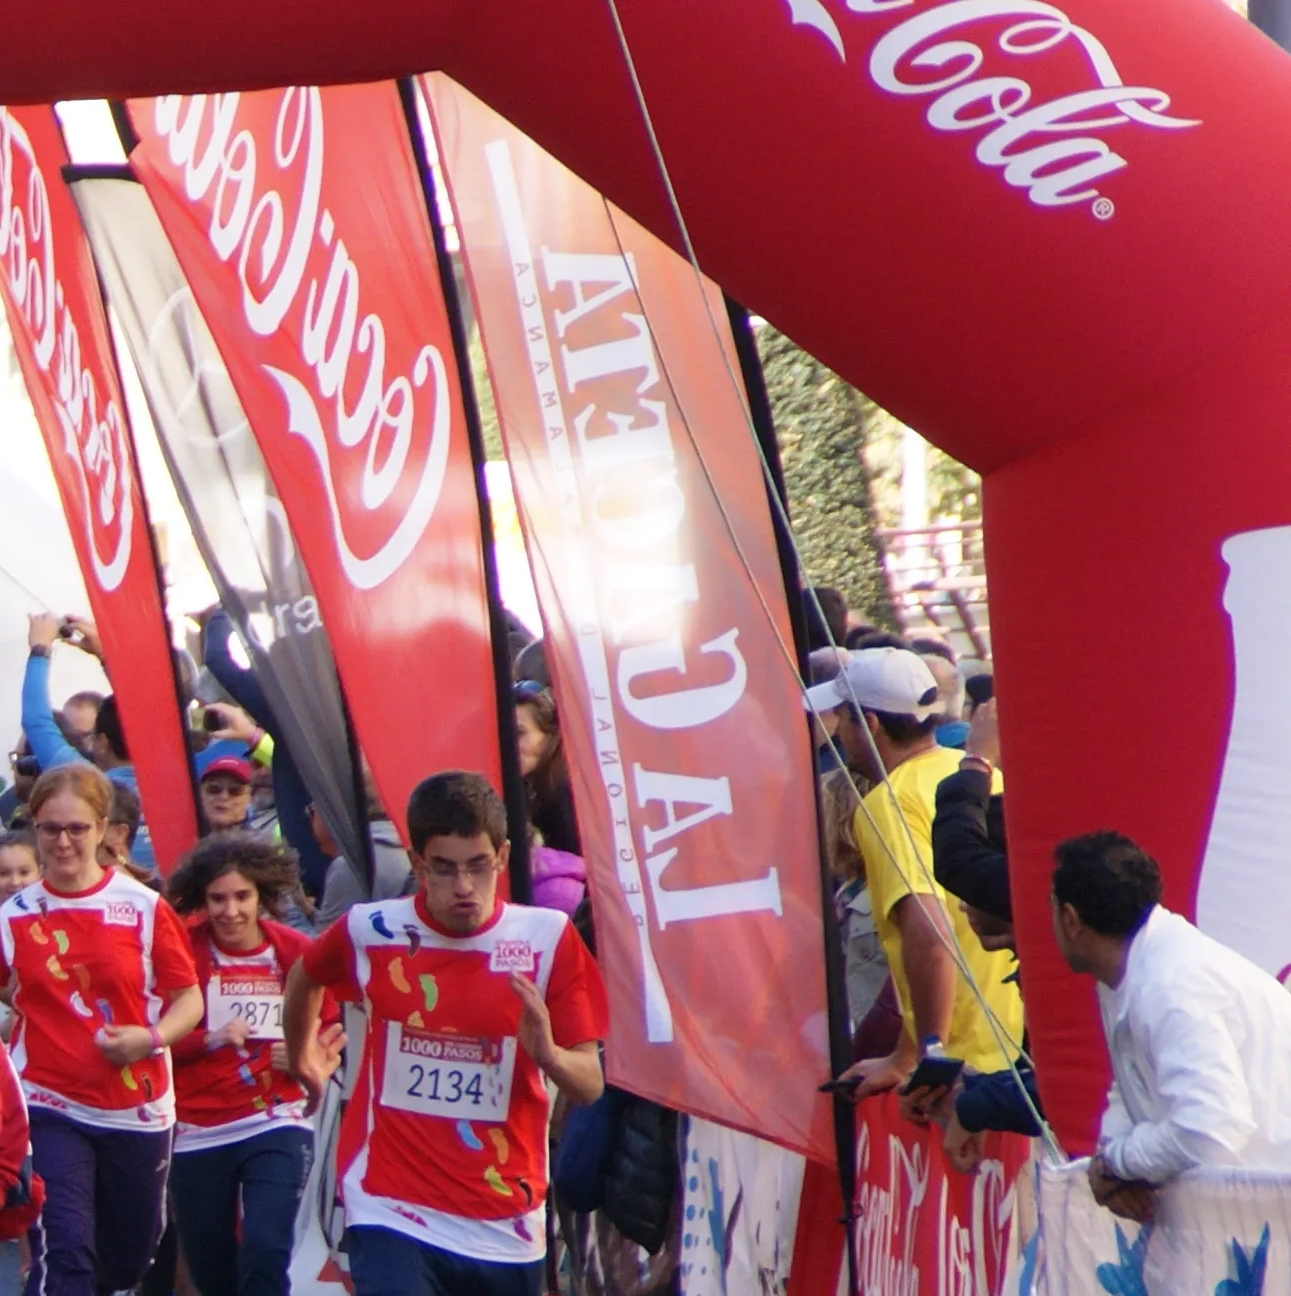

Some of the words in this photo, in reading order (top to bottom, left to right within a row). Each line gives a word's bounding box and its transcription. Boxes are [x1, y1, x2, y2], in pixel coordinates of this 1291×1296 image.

[401, 1037, 443, 1057] 1000
[443, 1045, 483, 1061] PASOS
[406, 1064, 484, 1105] 2134
